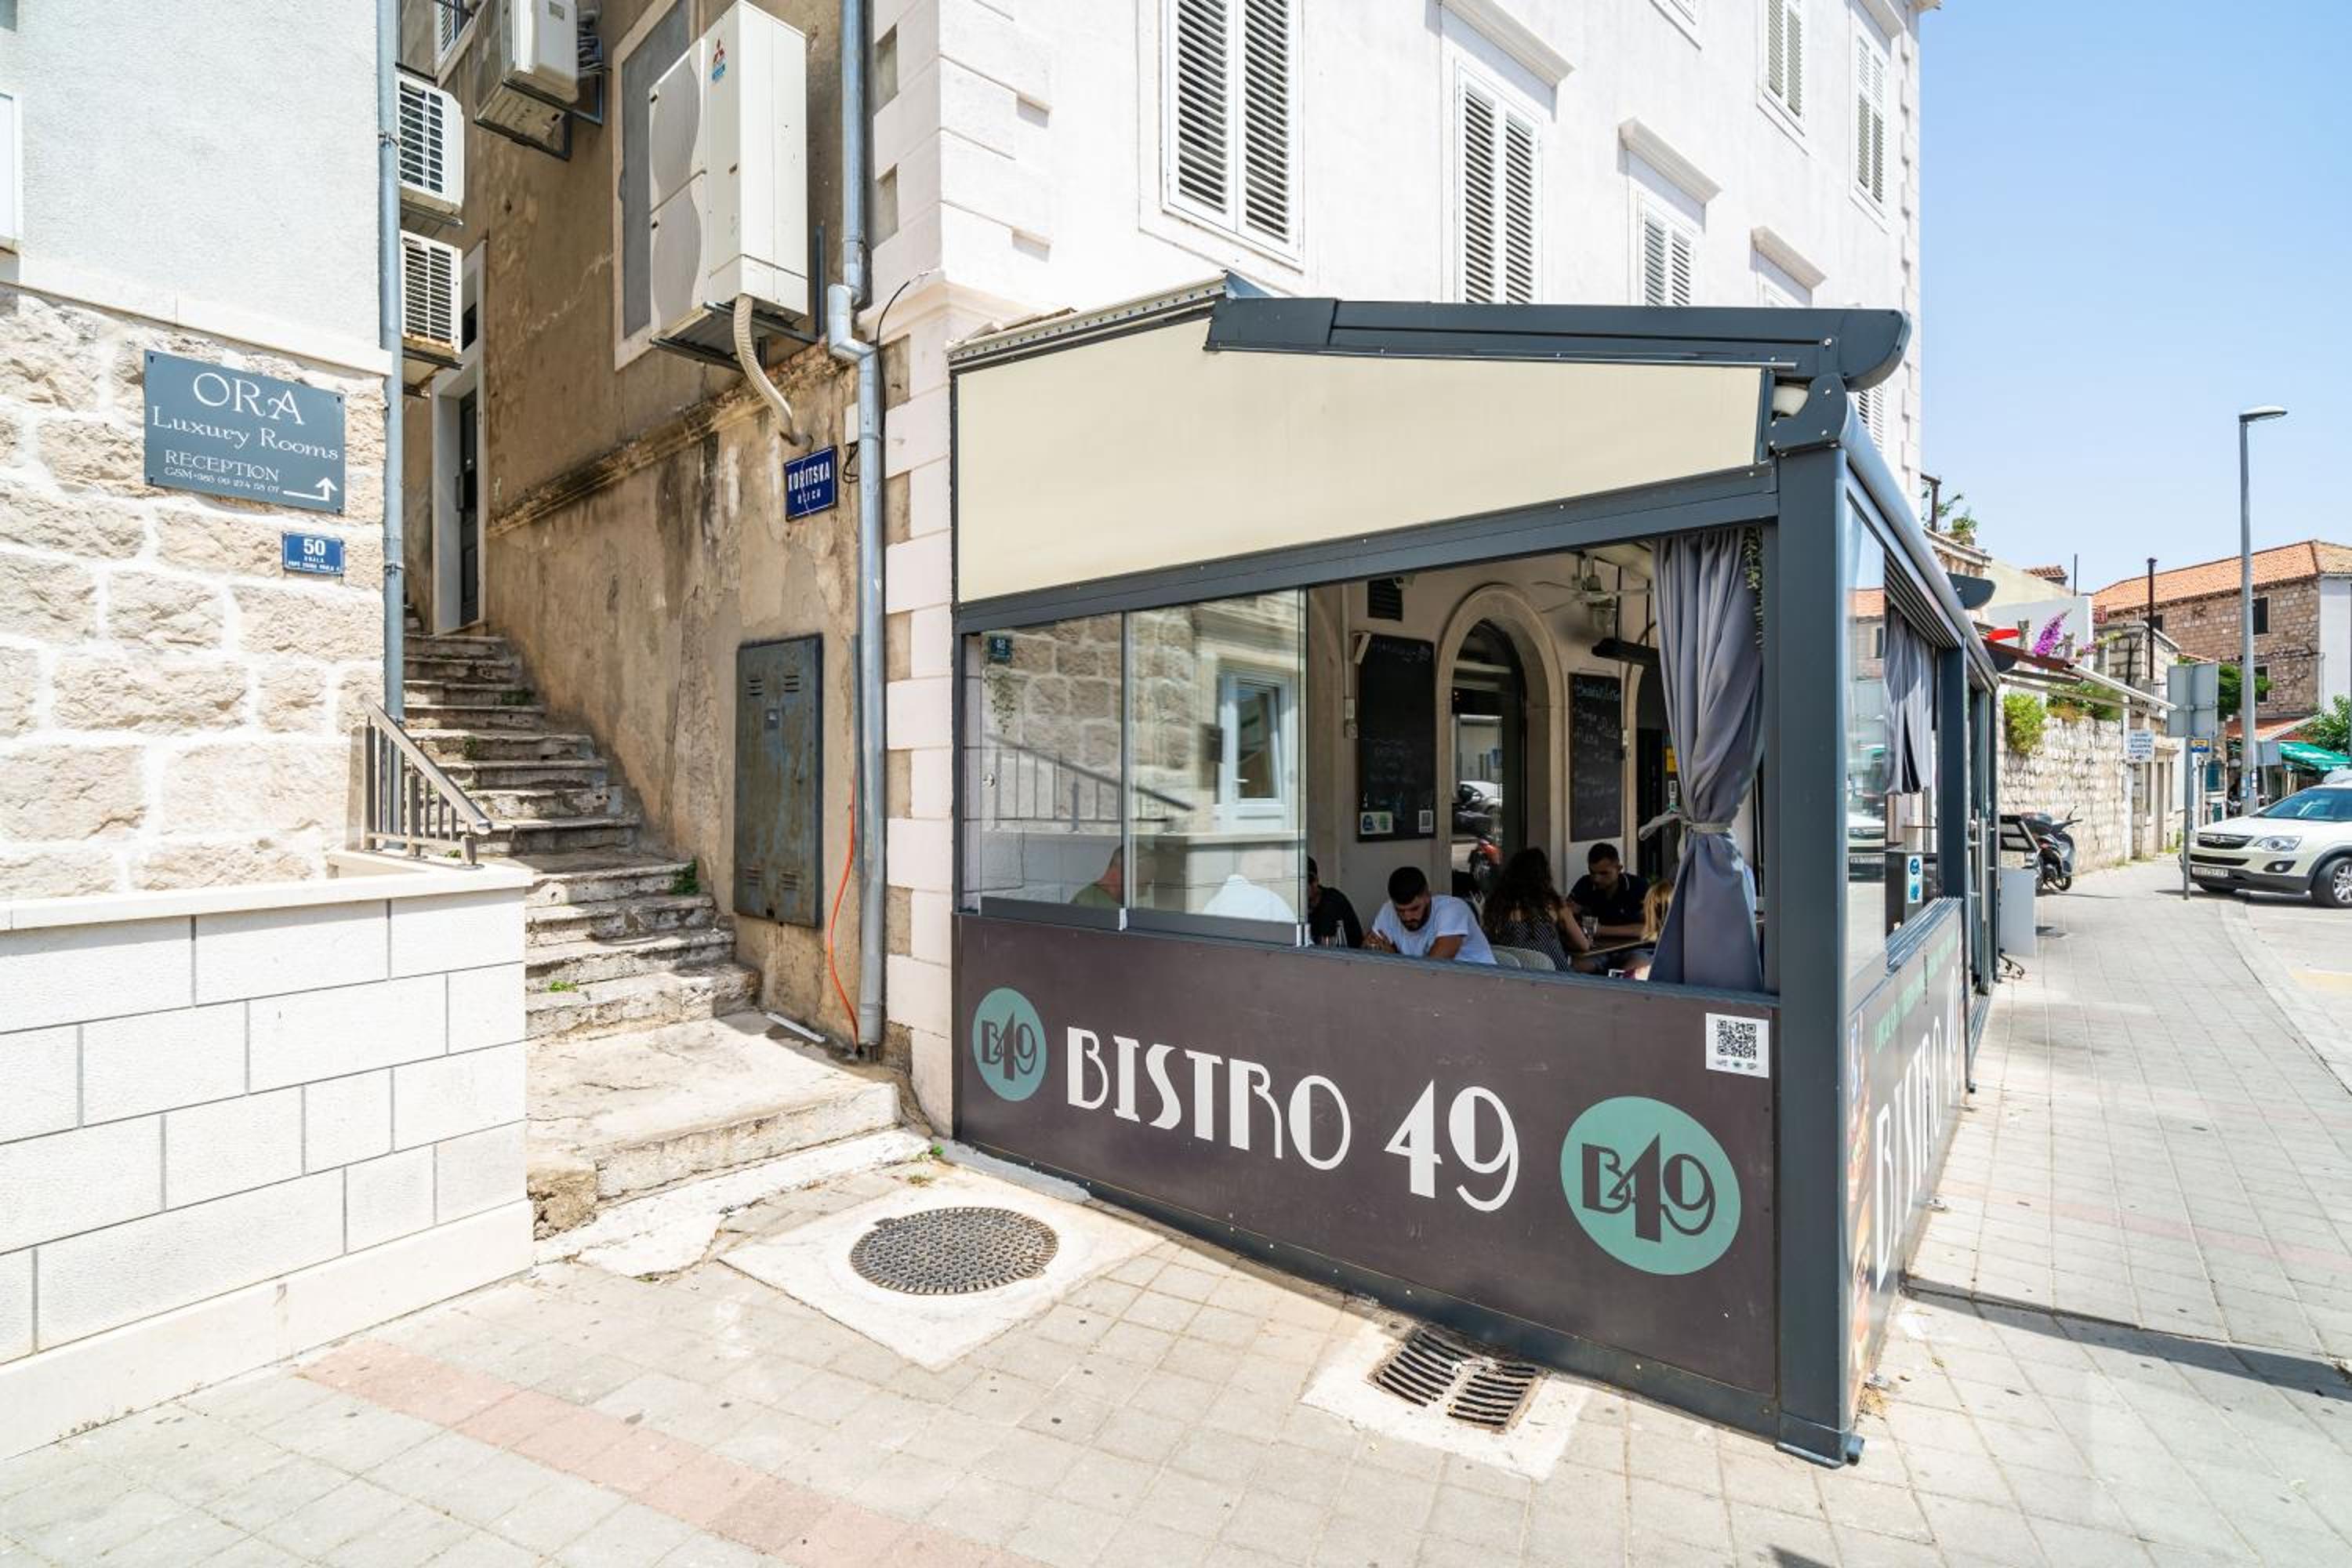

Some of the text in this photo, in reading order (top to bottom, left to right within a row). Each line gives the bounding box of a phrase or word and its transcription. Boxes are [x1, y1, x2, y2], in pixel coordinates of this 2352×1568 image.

[194, 372, 305, 425] ORA
[152, 405, 339, 460] Luxury Rooms
[165, 449, 279, 483] RECEPTION
[303, 539, 325, 556] 50
[1067, 1026, 1519, 1211] BISTRO 49
[1581, 1132, 1716, 1243] B49
